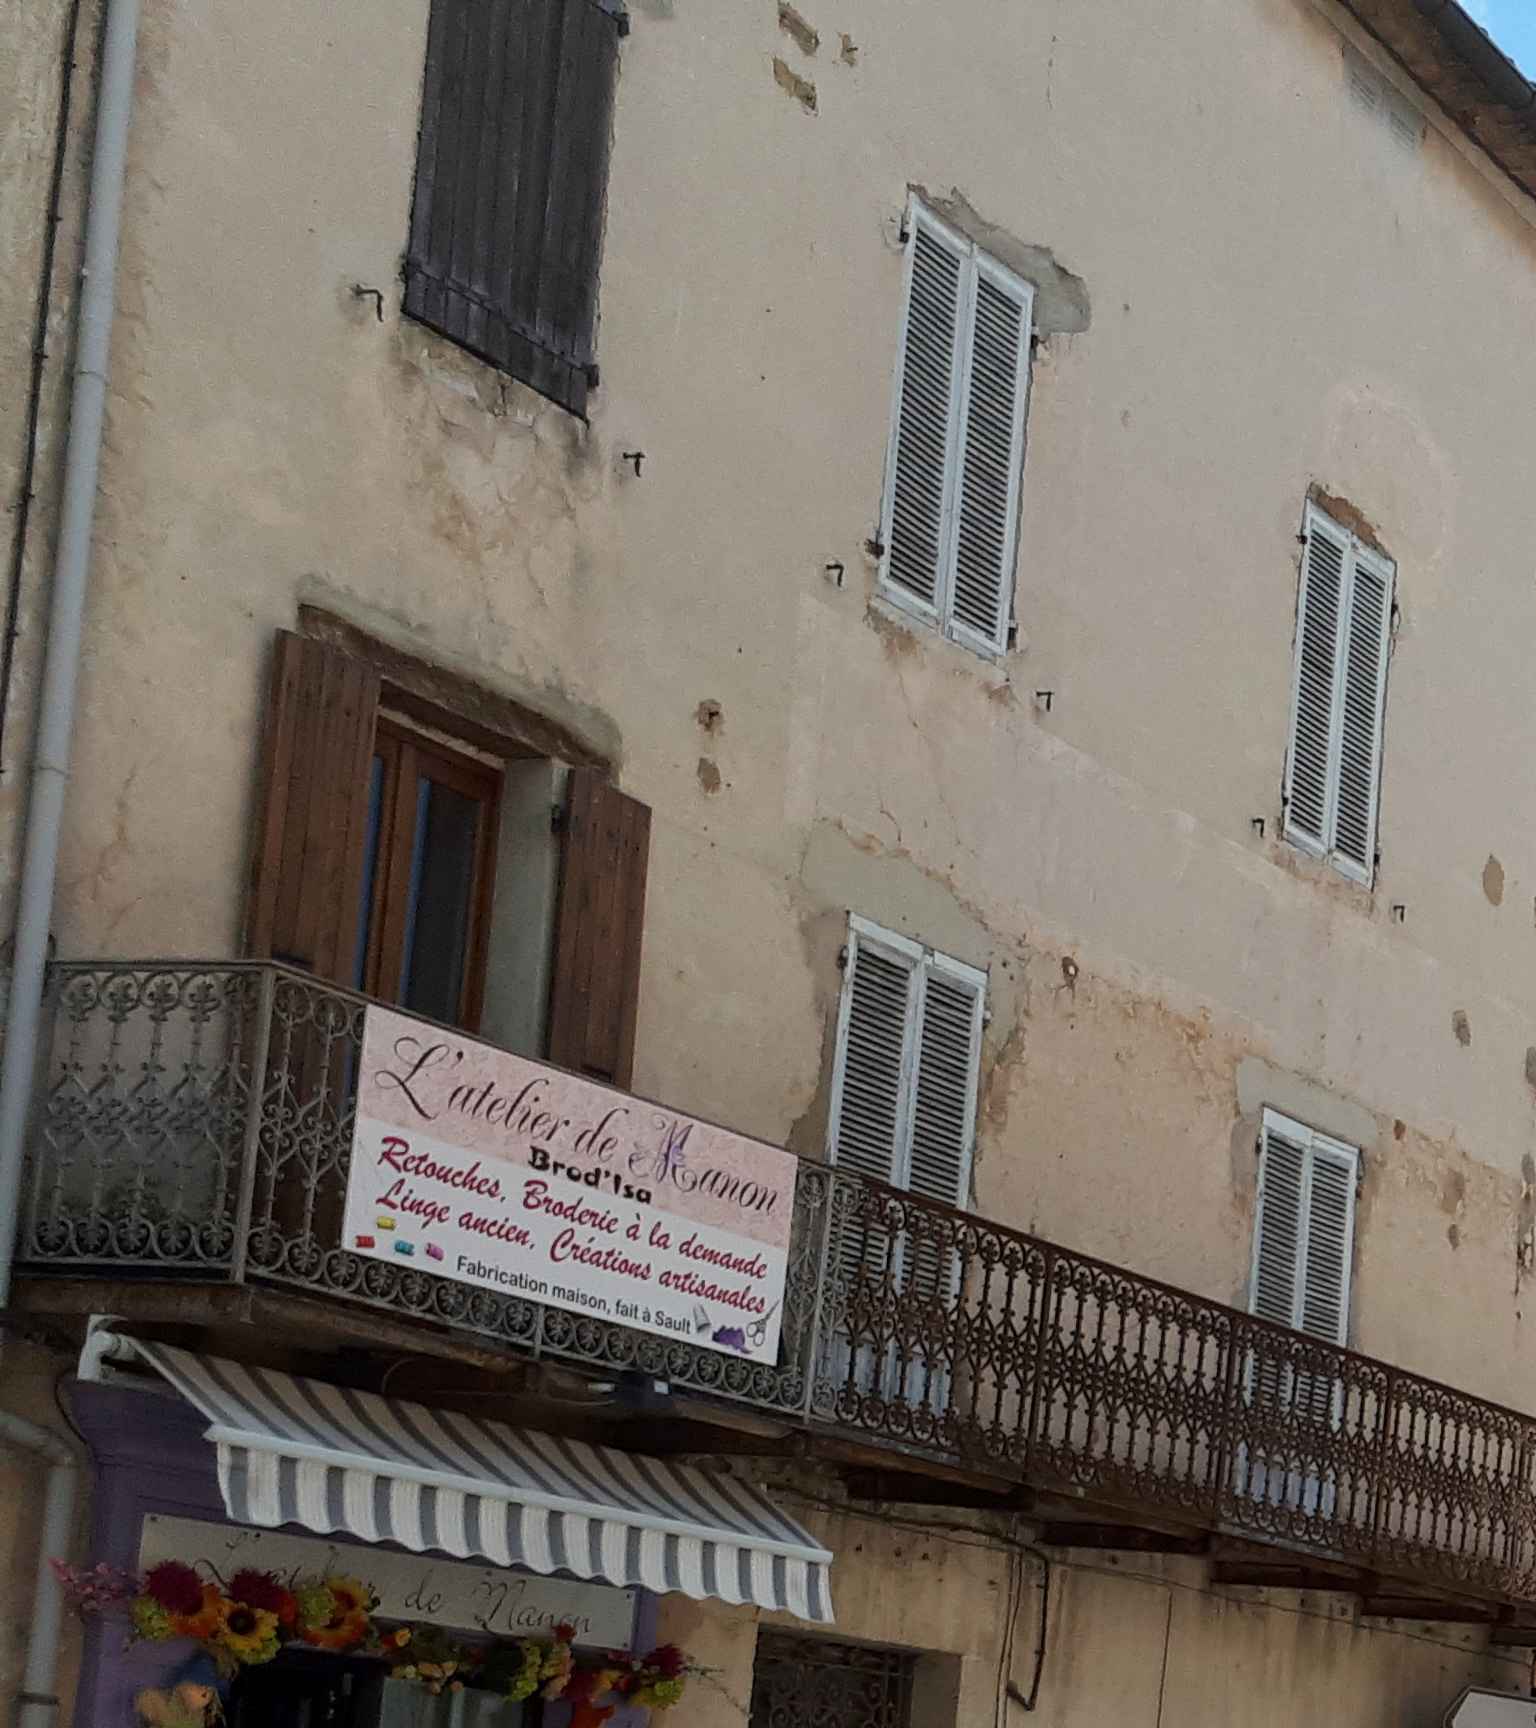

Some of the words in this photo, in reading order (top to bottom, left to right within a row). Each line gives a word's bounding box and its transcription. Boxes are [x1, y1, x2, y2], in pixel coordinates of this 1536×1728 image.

[375, 1036, 570, 1141] L'atelier
[574, 1107, 631, 1162] de
[628, 1112, 779, 1215] Manon
[527, 1146, 653, 1205] Brod'Isa
[375, 1178, 450, 1230] Linge
[458, 1209, 538, 1252] ancien,
[549, 1230, 653, 1282] Créations
[658, 1266, 766, 1315] artisanales
[376, 1136, 507, 1203] Retouches,
[522, 1179, 618, 1235] Broderie
[626, 1213, 643, 1241] à
[648, 1222, 671, 1252] la
[679, 1232, 768, 1282] demande
[456, 1255, 549, 1297] Fabrication
[551, 1282, 611, 1316] maison,
[614, 1299, 640, 1320] fait
[641, 1306, 653, 1323] à
[654, 1308, 692, 1335] Sault
[404, 1569, 443, 1614] de
